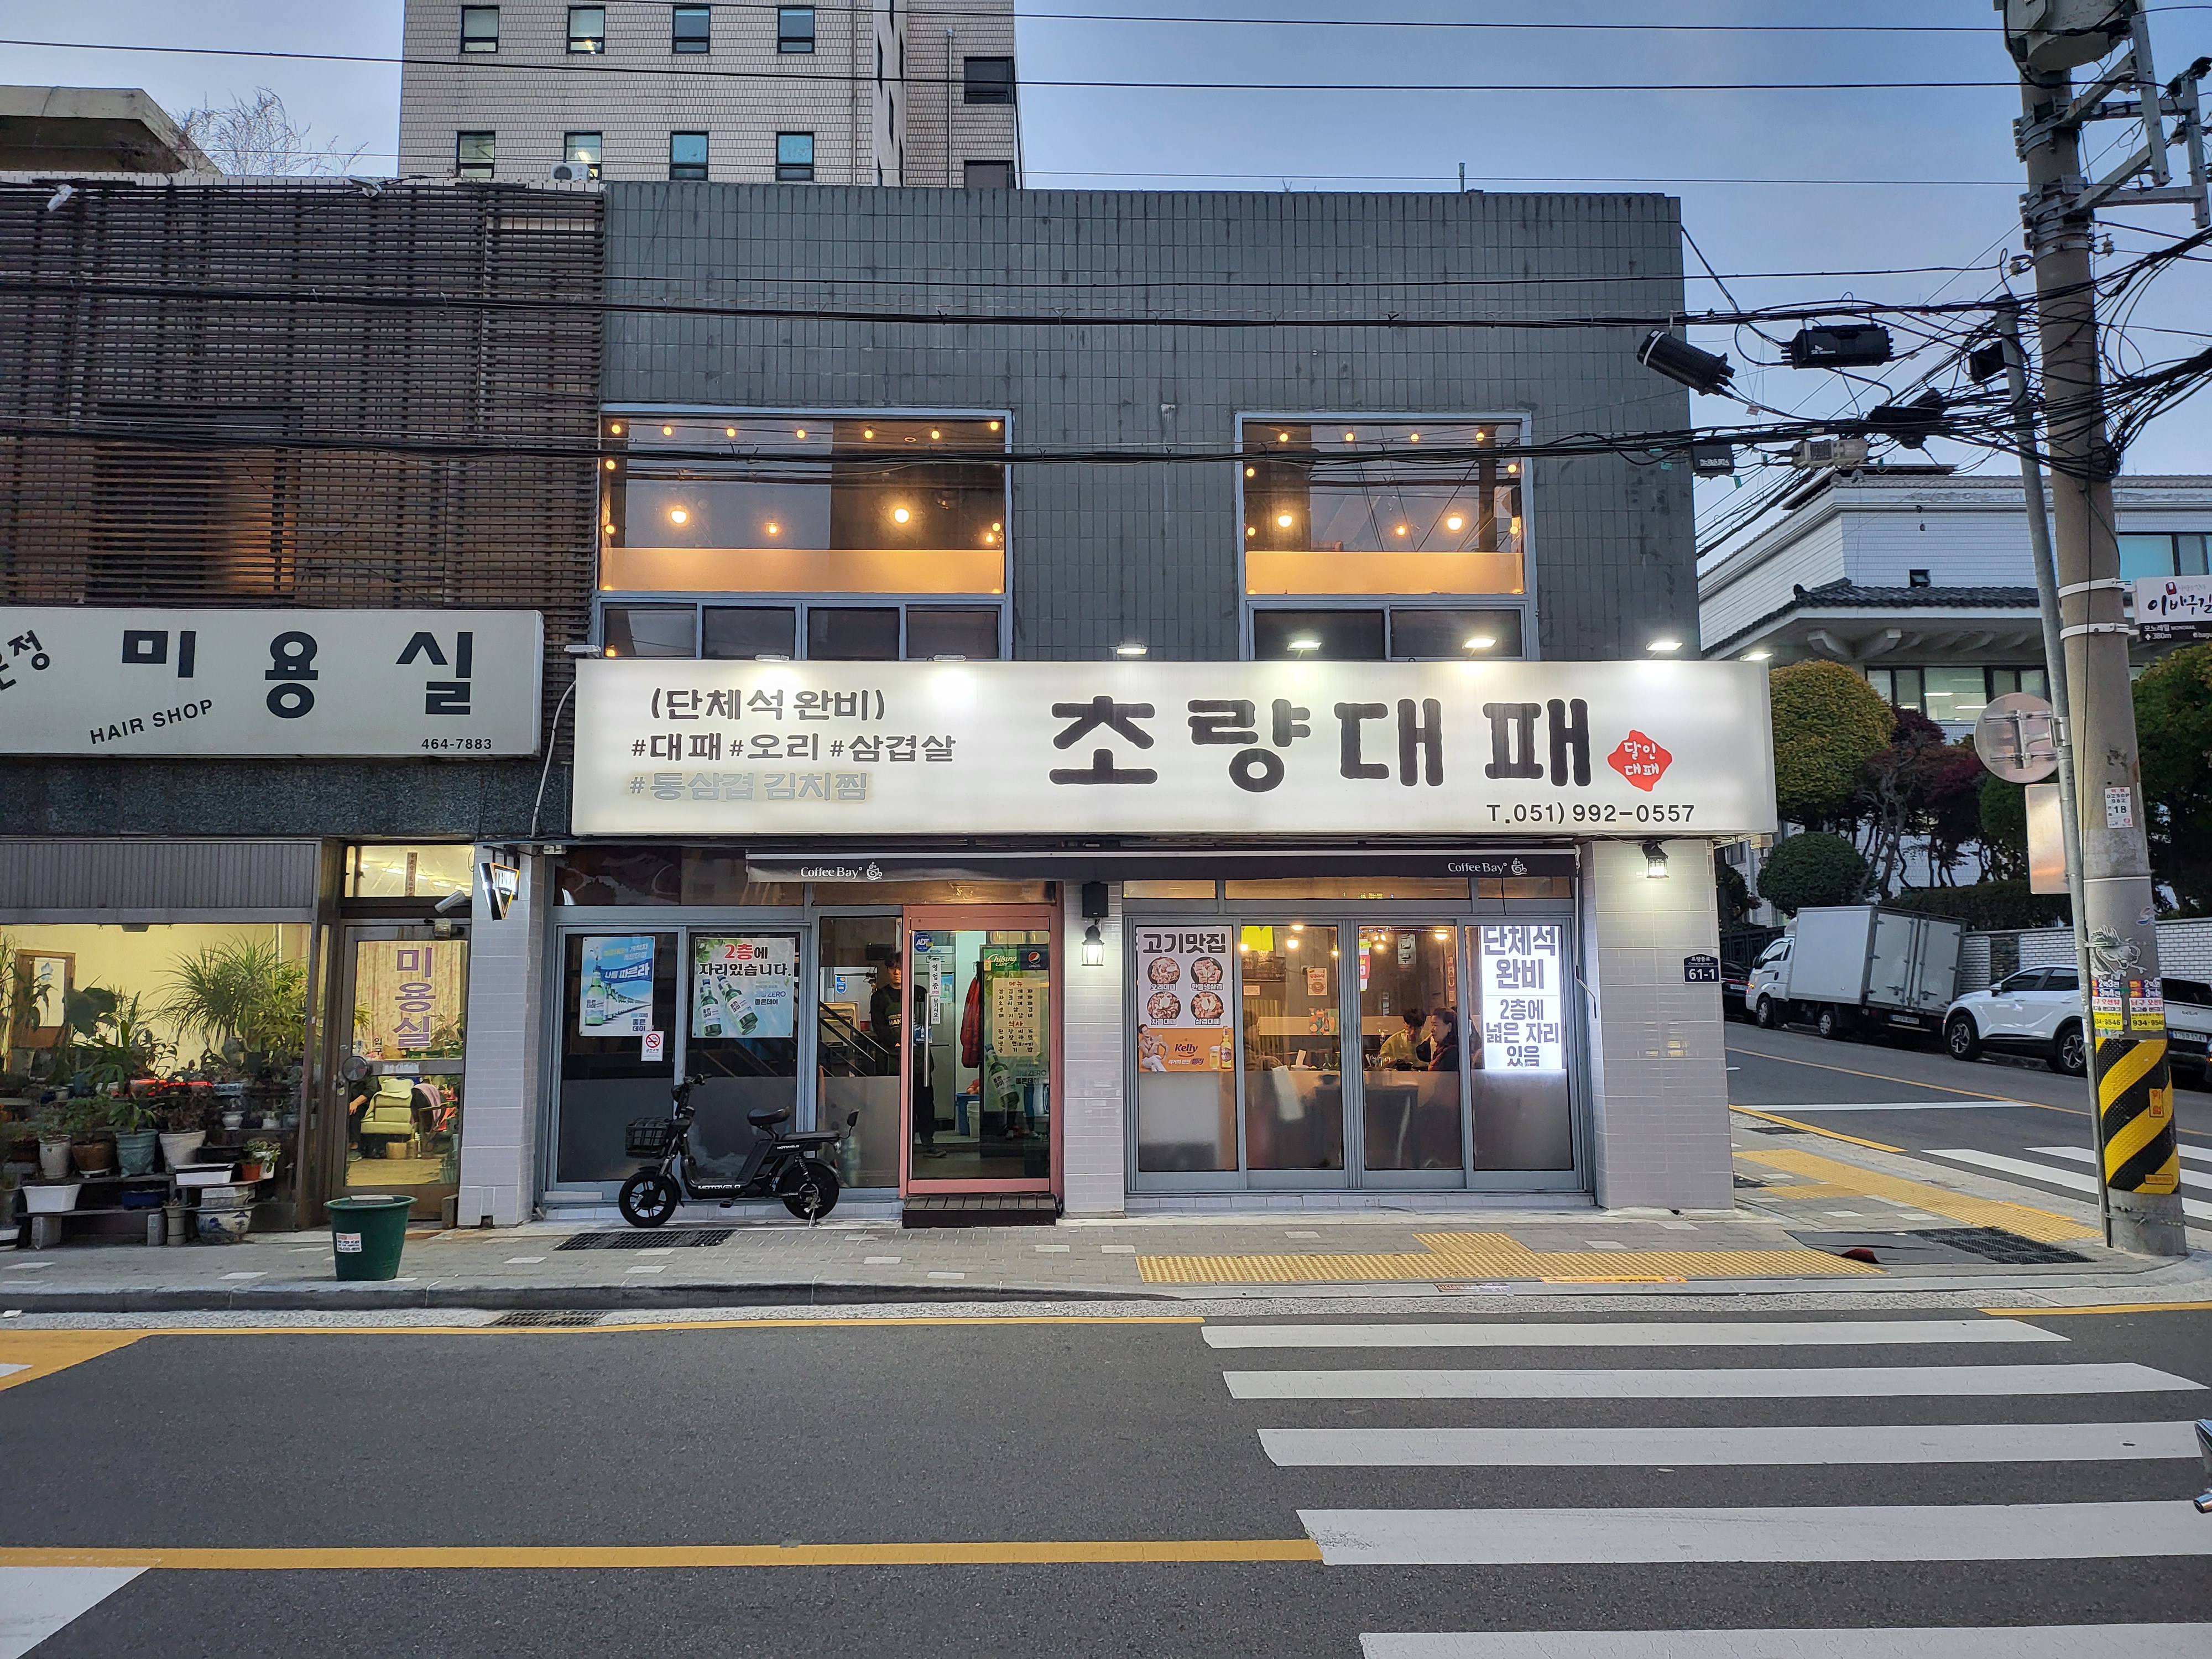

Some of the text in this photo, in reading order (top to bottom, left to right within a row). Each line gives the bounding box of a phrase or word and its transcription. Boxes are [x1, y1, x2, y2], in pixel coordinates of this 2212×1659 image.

[90, 698, 214, 745] HAIR SHOP
[421, 738, 492, 750] 464-7883
[632, 733, 957, 763] #대패 #오리 #삼겹살
[1048, 696, 1590, 793] 초량대패
[1623, 740, 1656, 760] 달인
[1624, 763, 1660, 776] 대패
[763, 773, 868, 801] 김치찜
[2113, 805, 2127, 813] 18
[800, 867, 859, 879] Coffee Bay
[1448, 862, 1504, 875] Coffee Bay
[915, 938, 930, 946] ADT
[1142, 933, 1226, 954] 고기맛집
[1483, 926, 1556, 956] 단체석
[723, 942, 768, 960] 2층에
[619, 962, 650, 978] 따르라
[698, 963, 792, 977] 자리있습니다.
[1496, 958, 1545, 989] 완비
[1689, 968, 1715, 980] 61-1
[392, 947, 436, 1047] 미용실
[1500, 999, 1544, 1020] 2층에
[1485, 1022, 1559, 1044] 넓은 자리
[374, 1037, 383, 1055] 입구
[1174, 1044, 1198, 1054] Kelly
[1506, 1045, 1540, 1067] 있음
